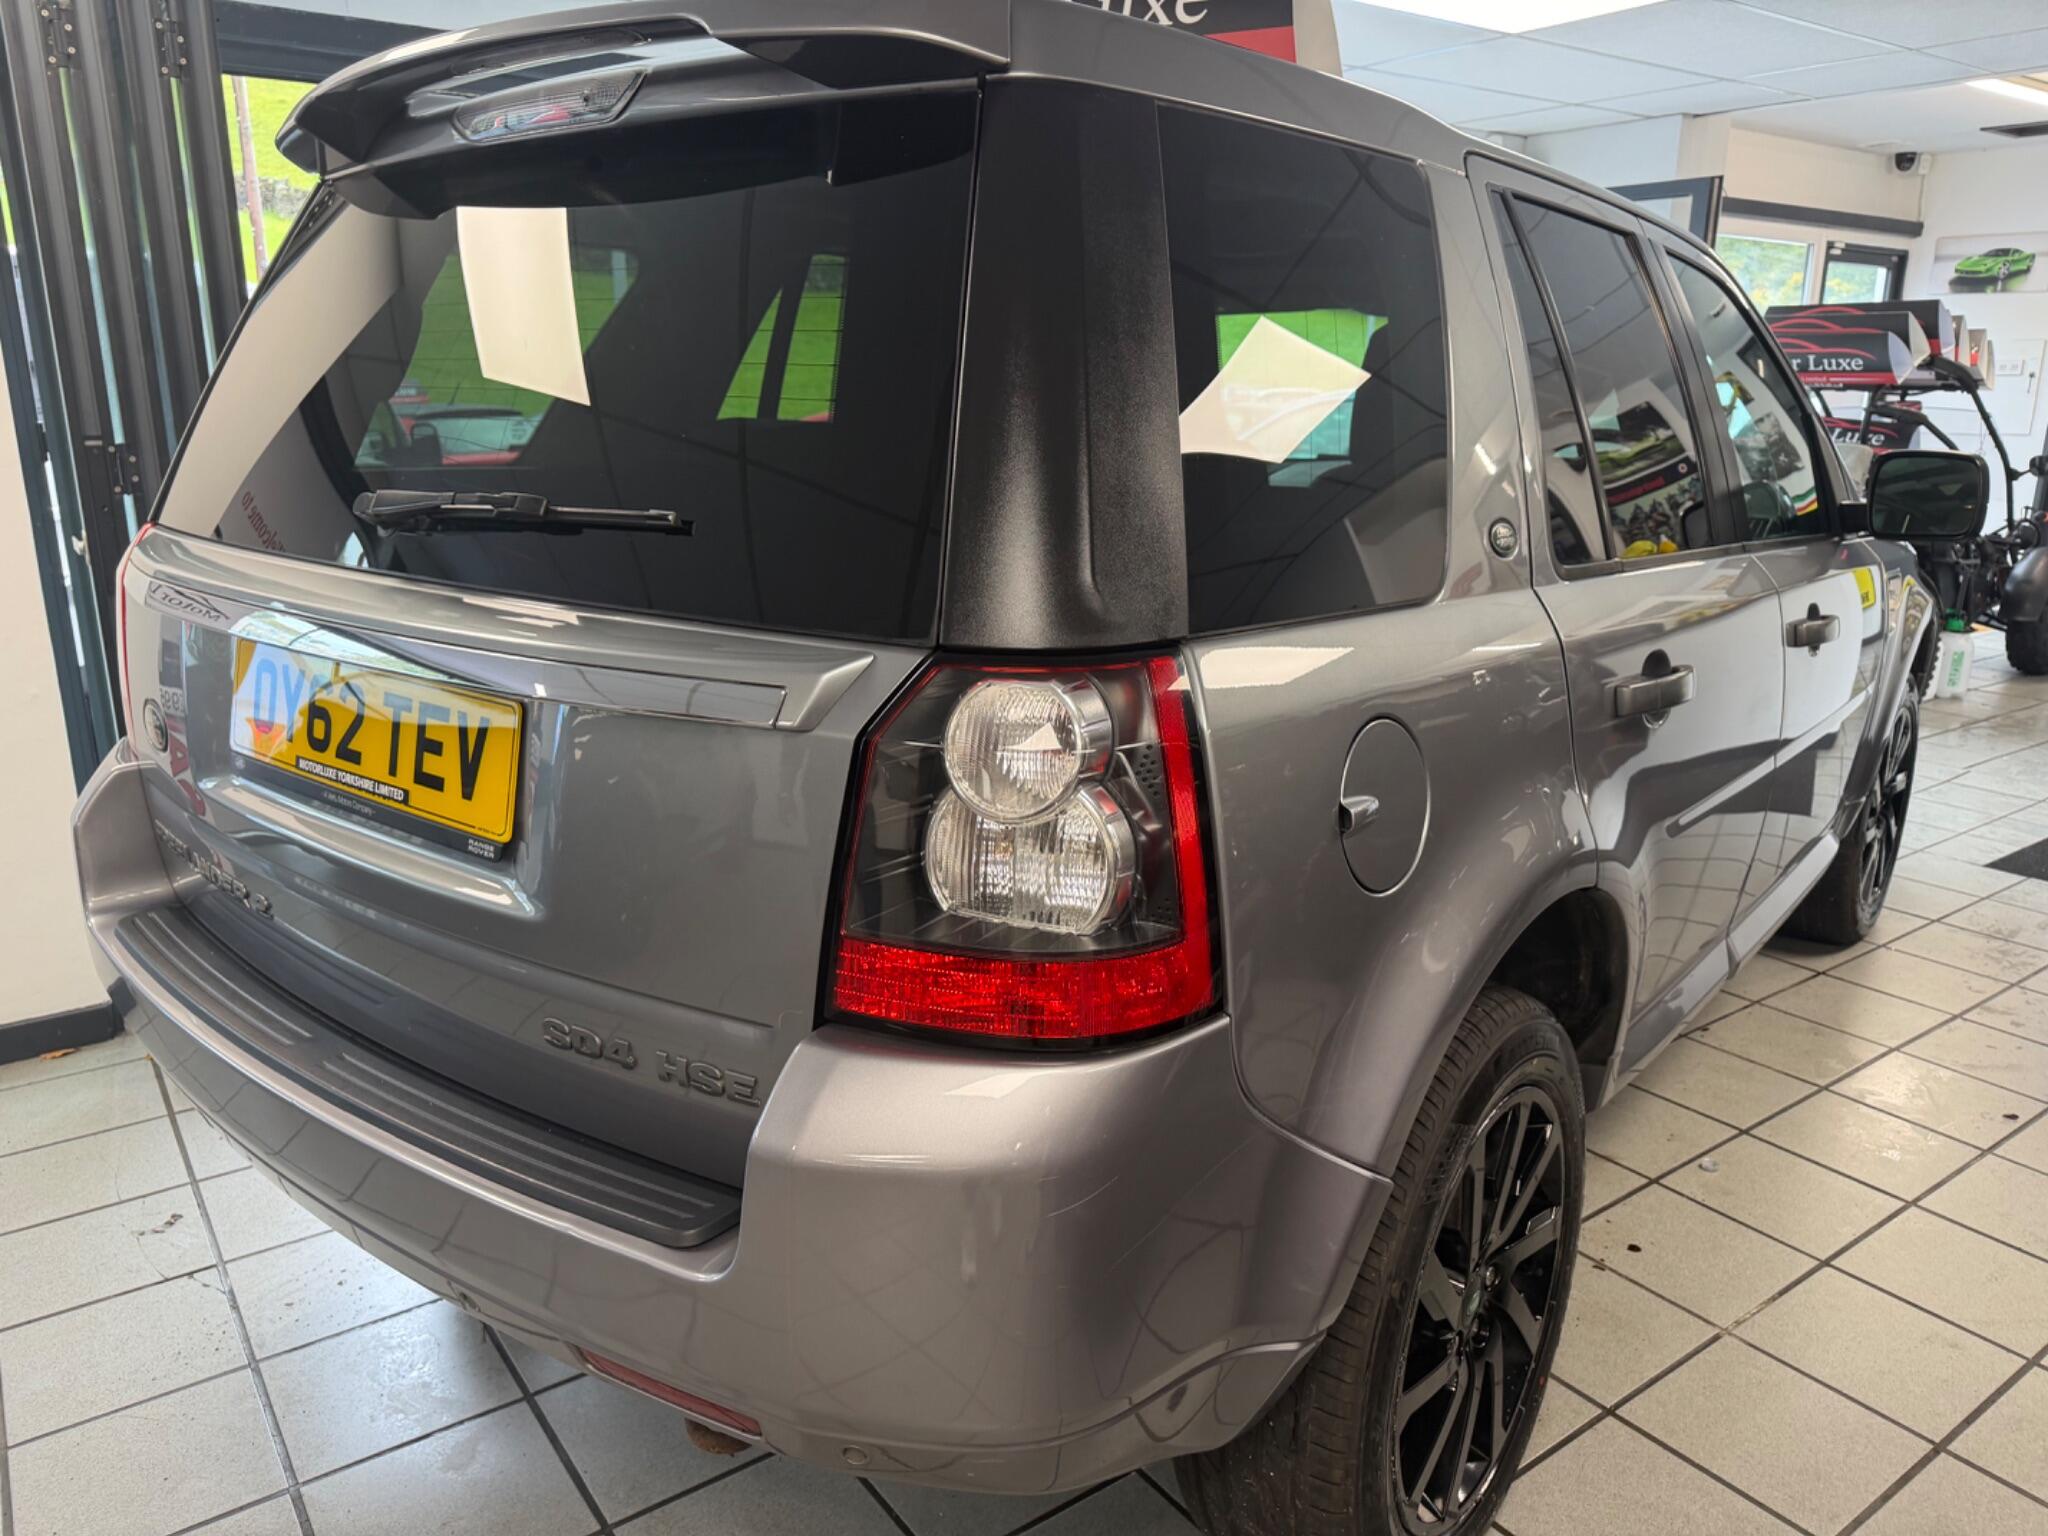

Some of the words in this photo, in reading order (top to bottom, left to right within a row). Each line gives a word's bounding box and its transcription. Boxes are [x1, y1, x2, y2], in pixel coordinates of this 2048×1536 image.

[1807, 354, 1864, 371] Luxe
[299, 758, 337, 781] MOTORLUXE
[337, 770, 375, 793] YORKSHIRE
[375, 781, 405, 801] LIMITED
[383, 691, 492, 802] TEV
[543, 1017, 638, 1070] SD4
[656, 1050, 761, 1107] HSE
